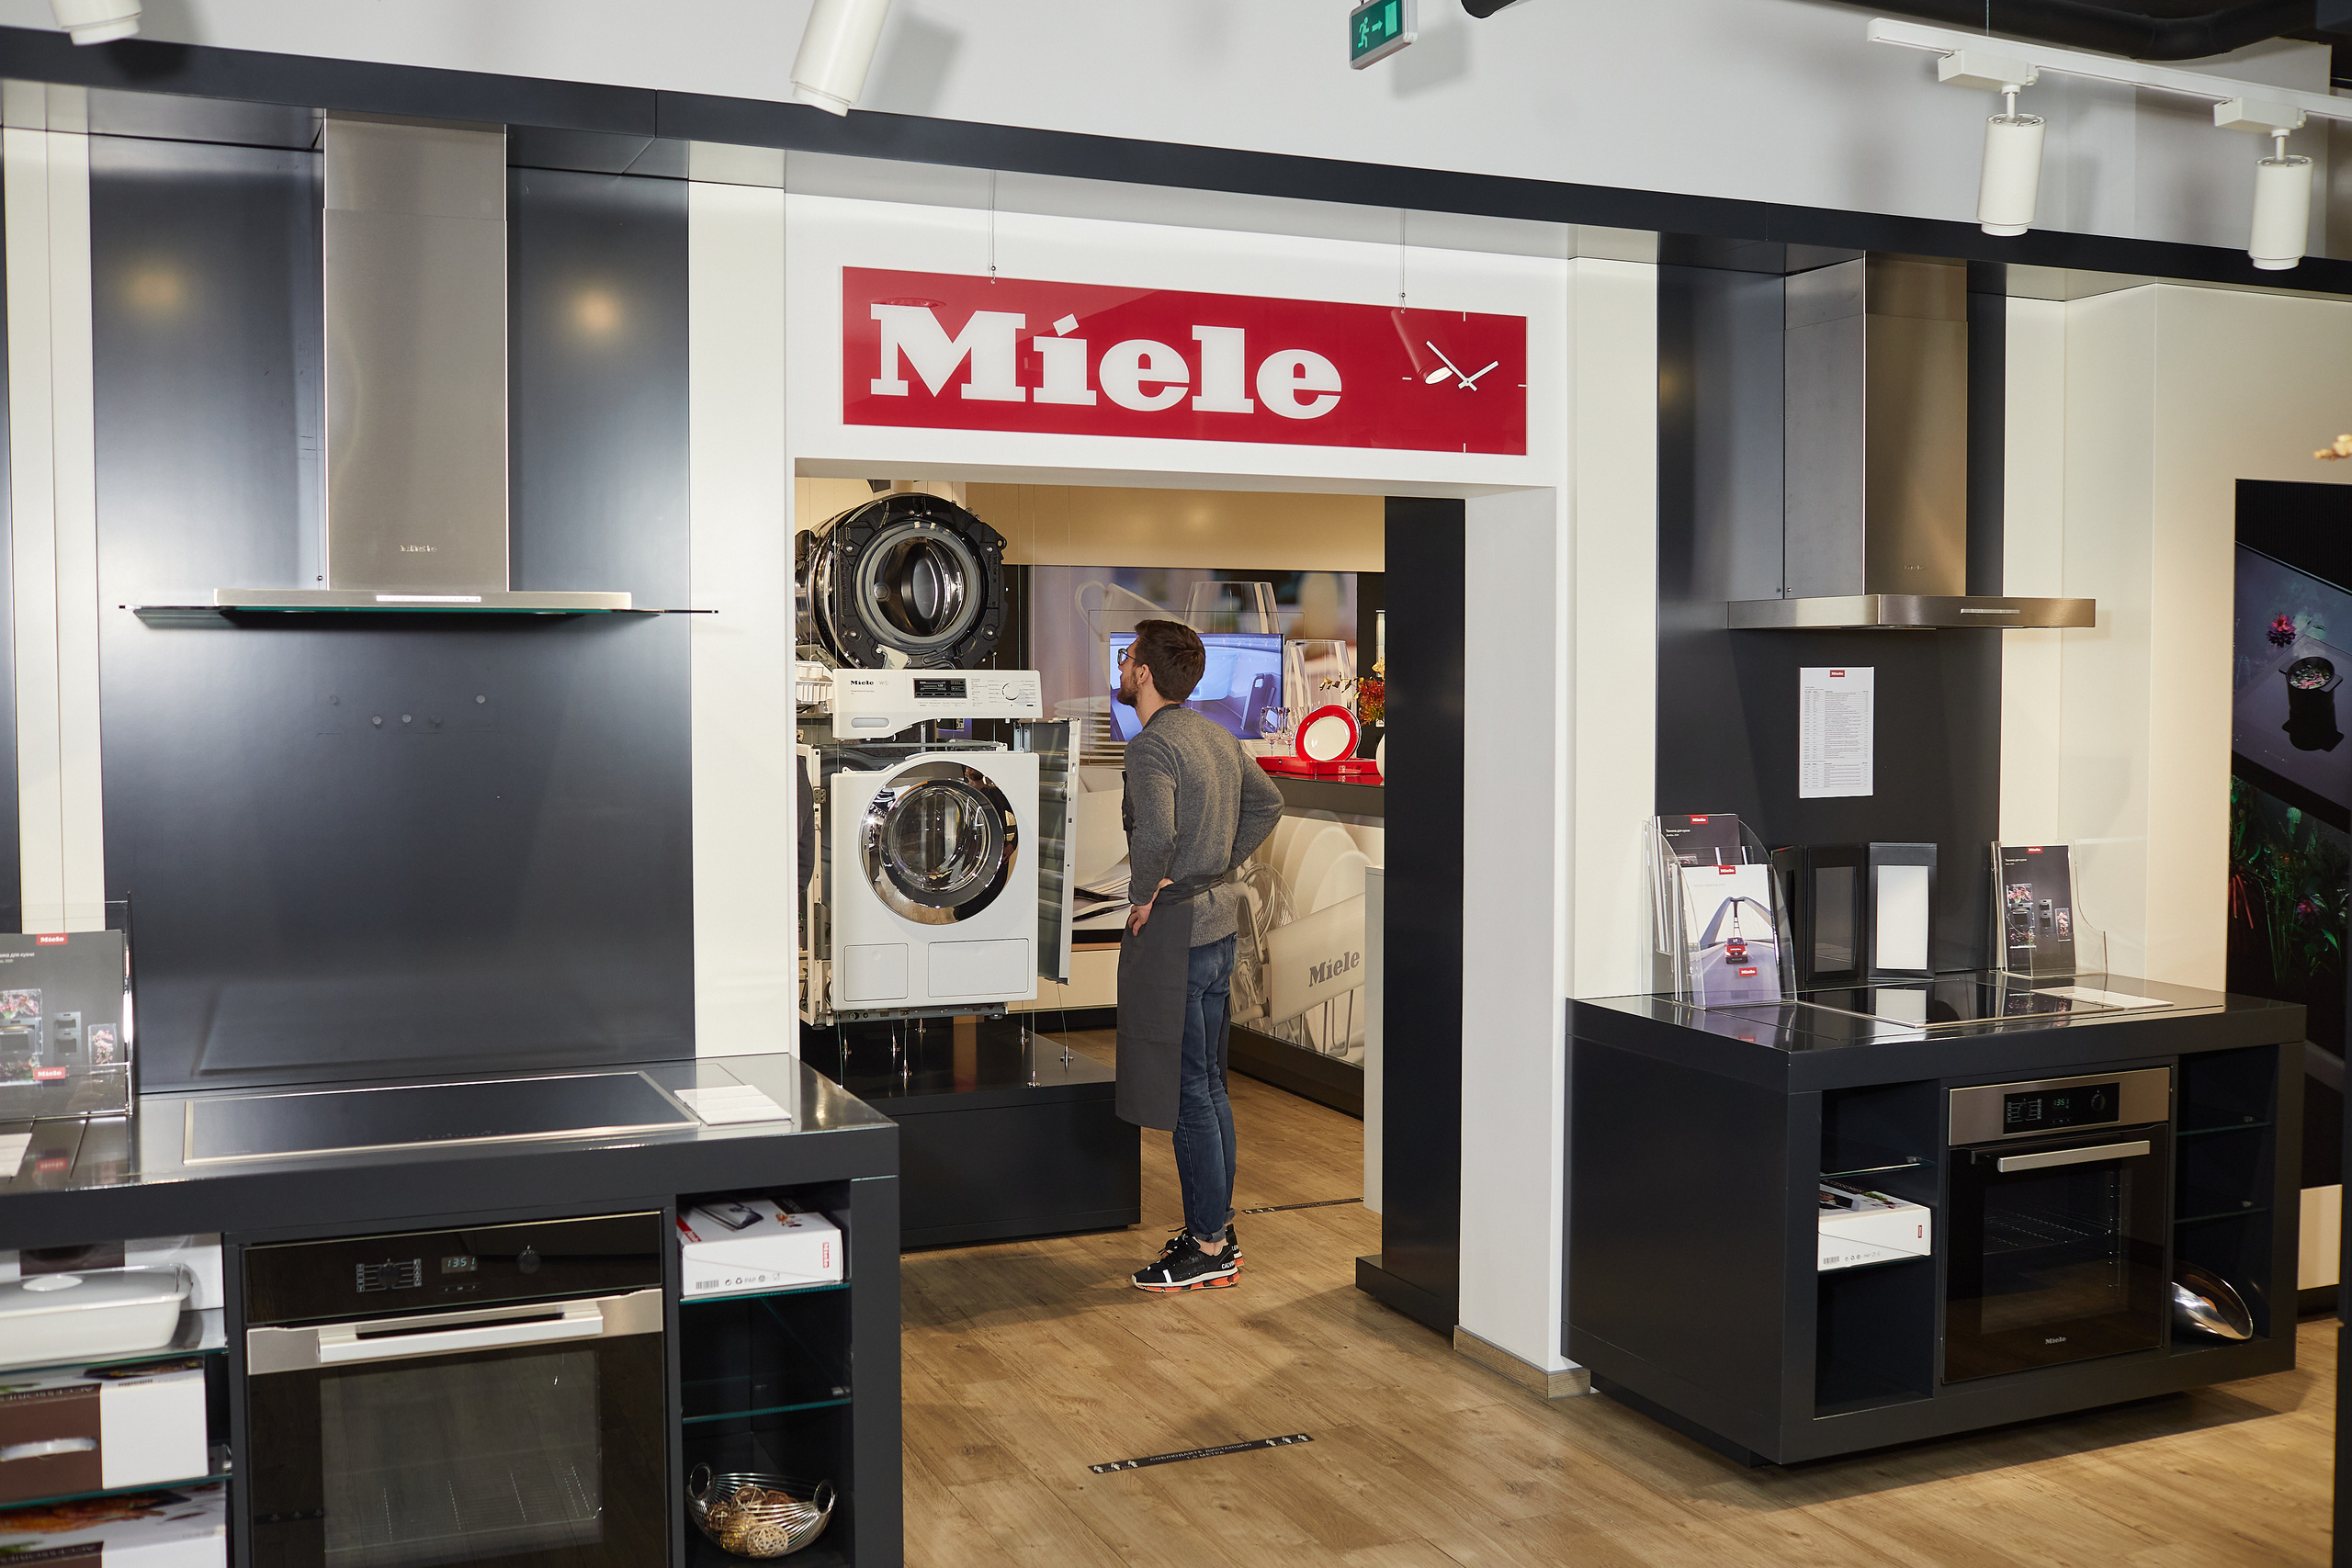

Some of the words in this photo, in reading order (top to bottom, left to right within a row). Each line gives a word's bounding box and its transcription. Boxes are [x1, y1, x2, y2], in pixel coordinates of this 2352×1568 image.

[871, 303, 1341, 420] Miele
[40, 935, 65, 943] Miele
[1308, 951, 1360, 988] Miele
[37, 1069, 62, 1077] Miele
[2045, 1337, 2067, 1345] Miele
